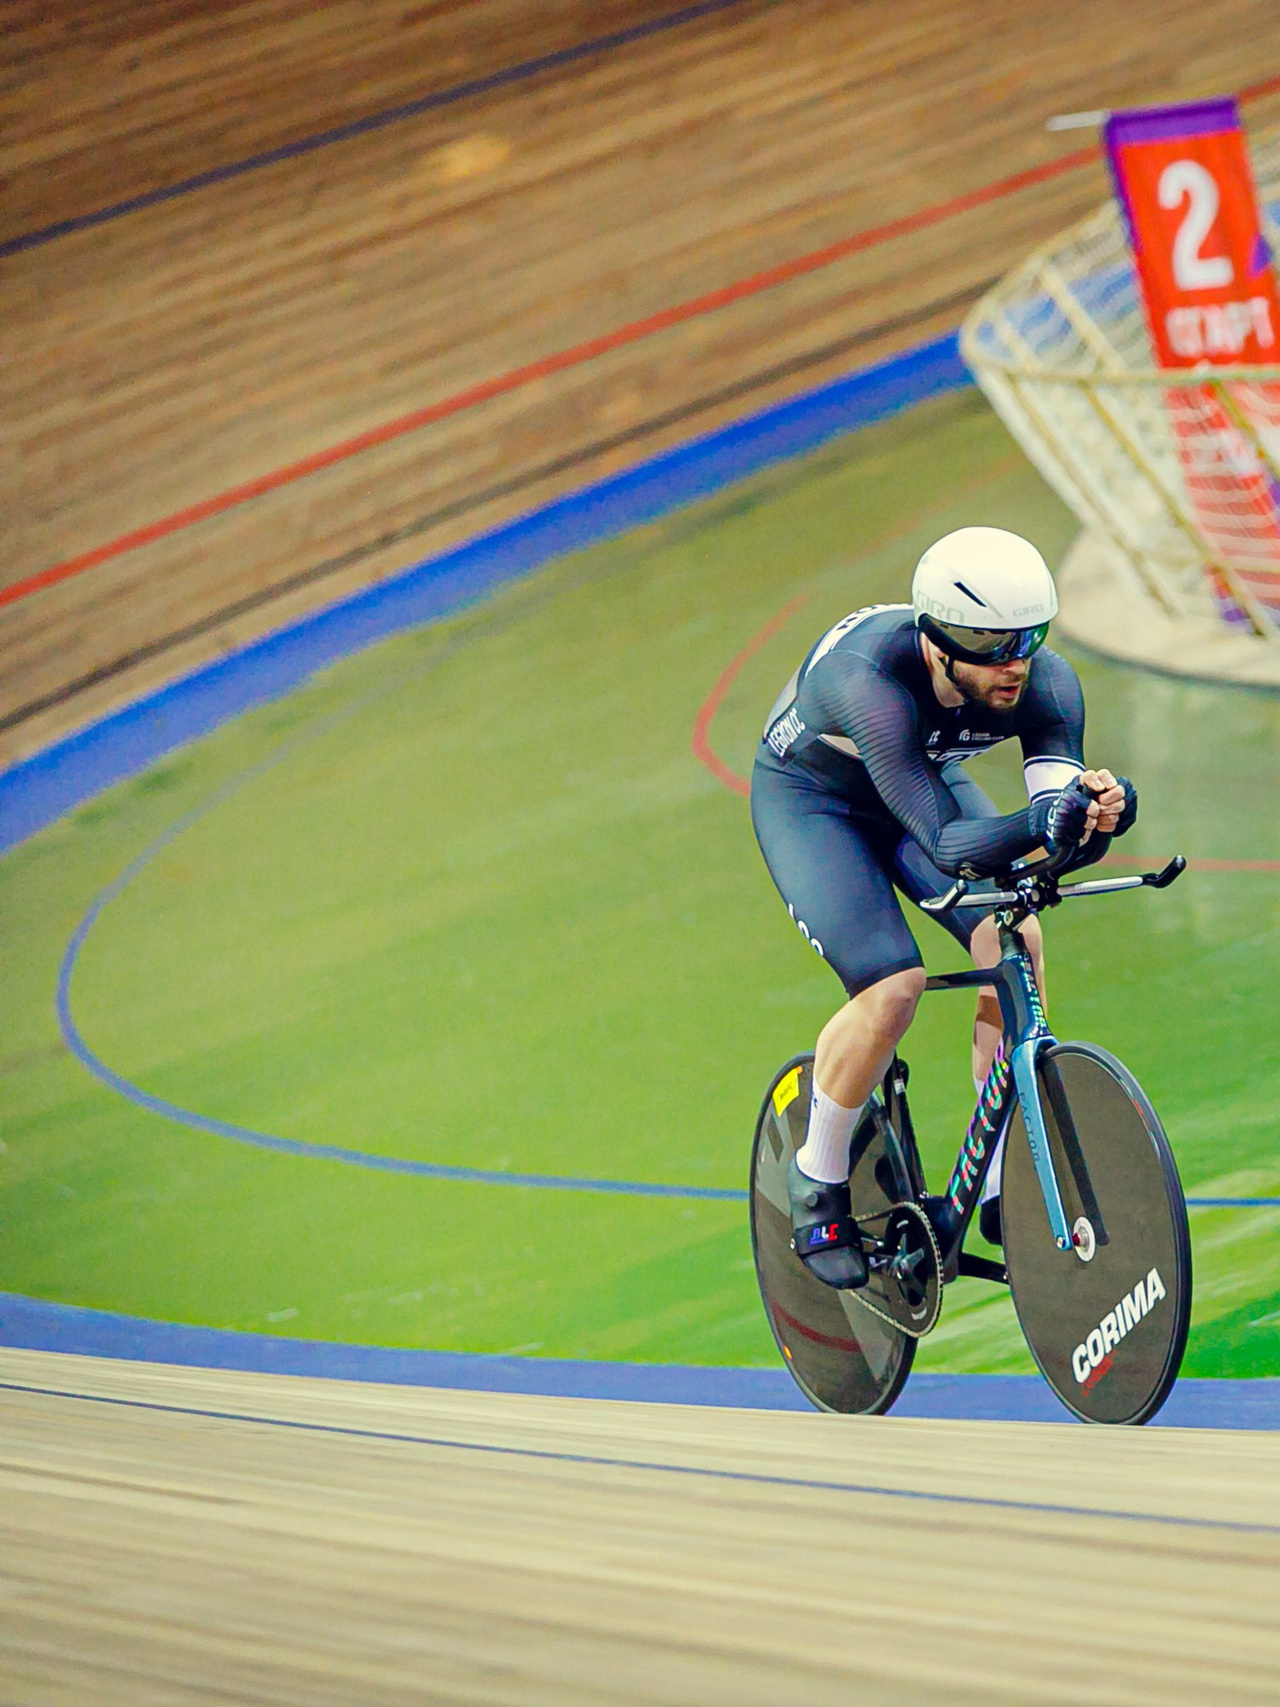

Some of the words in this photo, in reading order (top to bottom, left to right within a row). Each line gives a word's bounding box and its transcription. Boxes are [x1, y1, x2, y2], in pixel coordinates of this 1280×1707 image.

[1157, 159, 1234, 291] 2
[1012, 603, 1044, 617] GIRO
[1018, 1092, 1041, 1164] FACTOR
[1072, 1266, 1167, 1384] CORIMA
